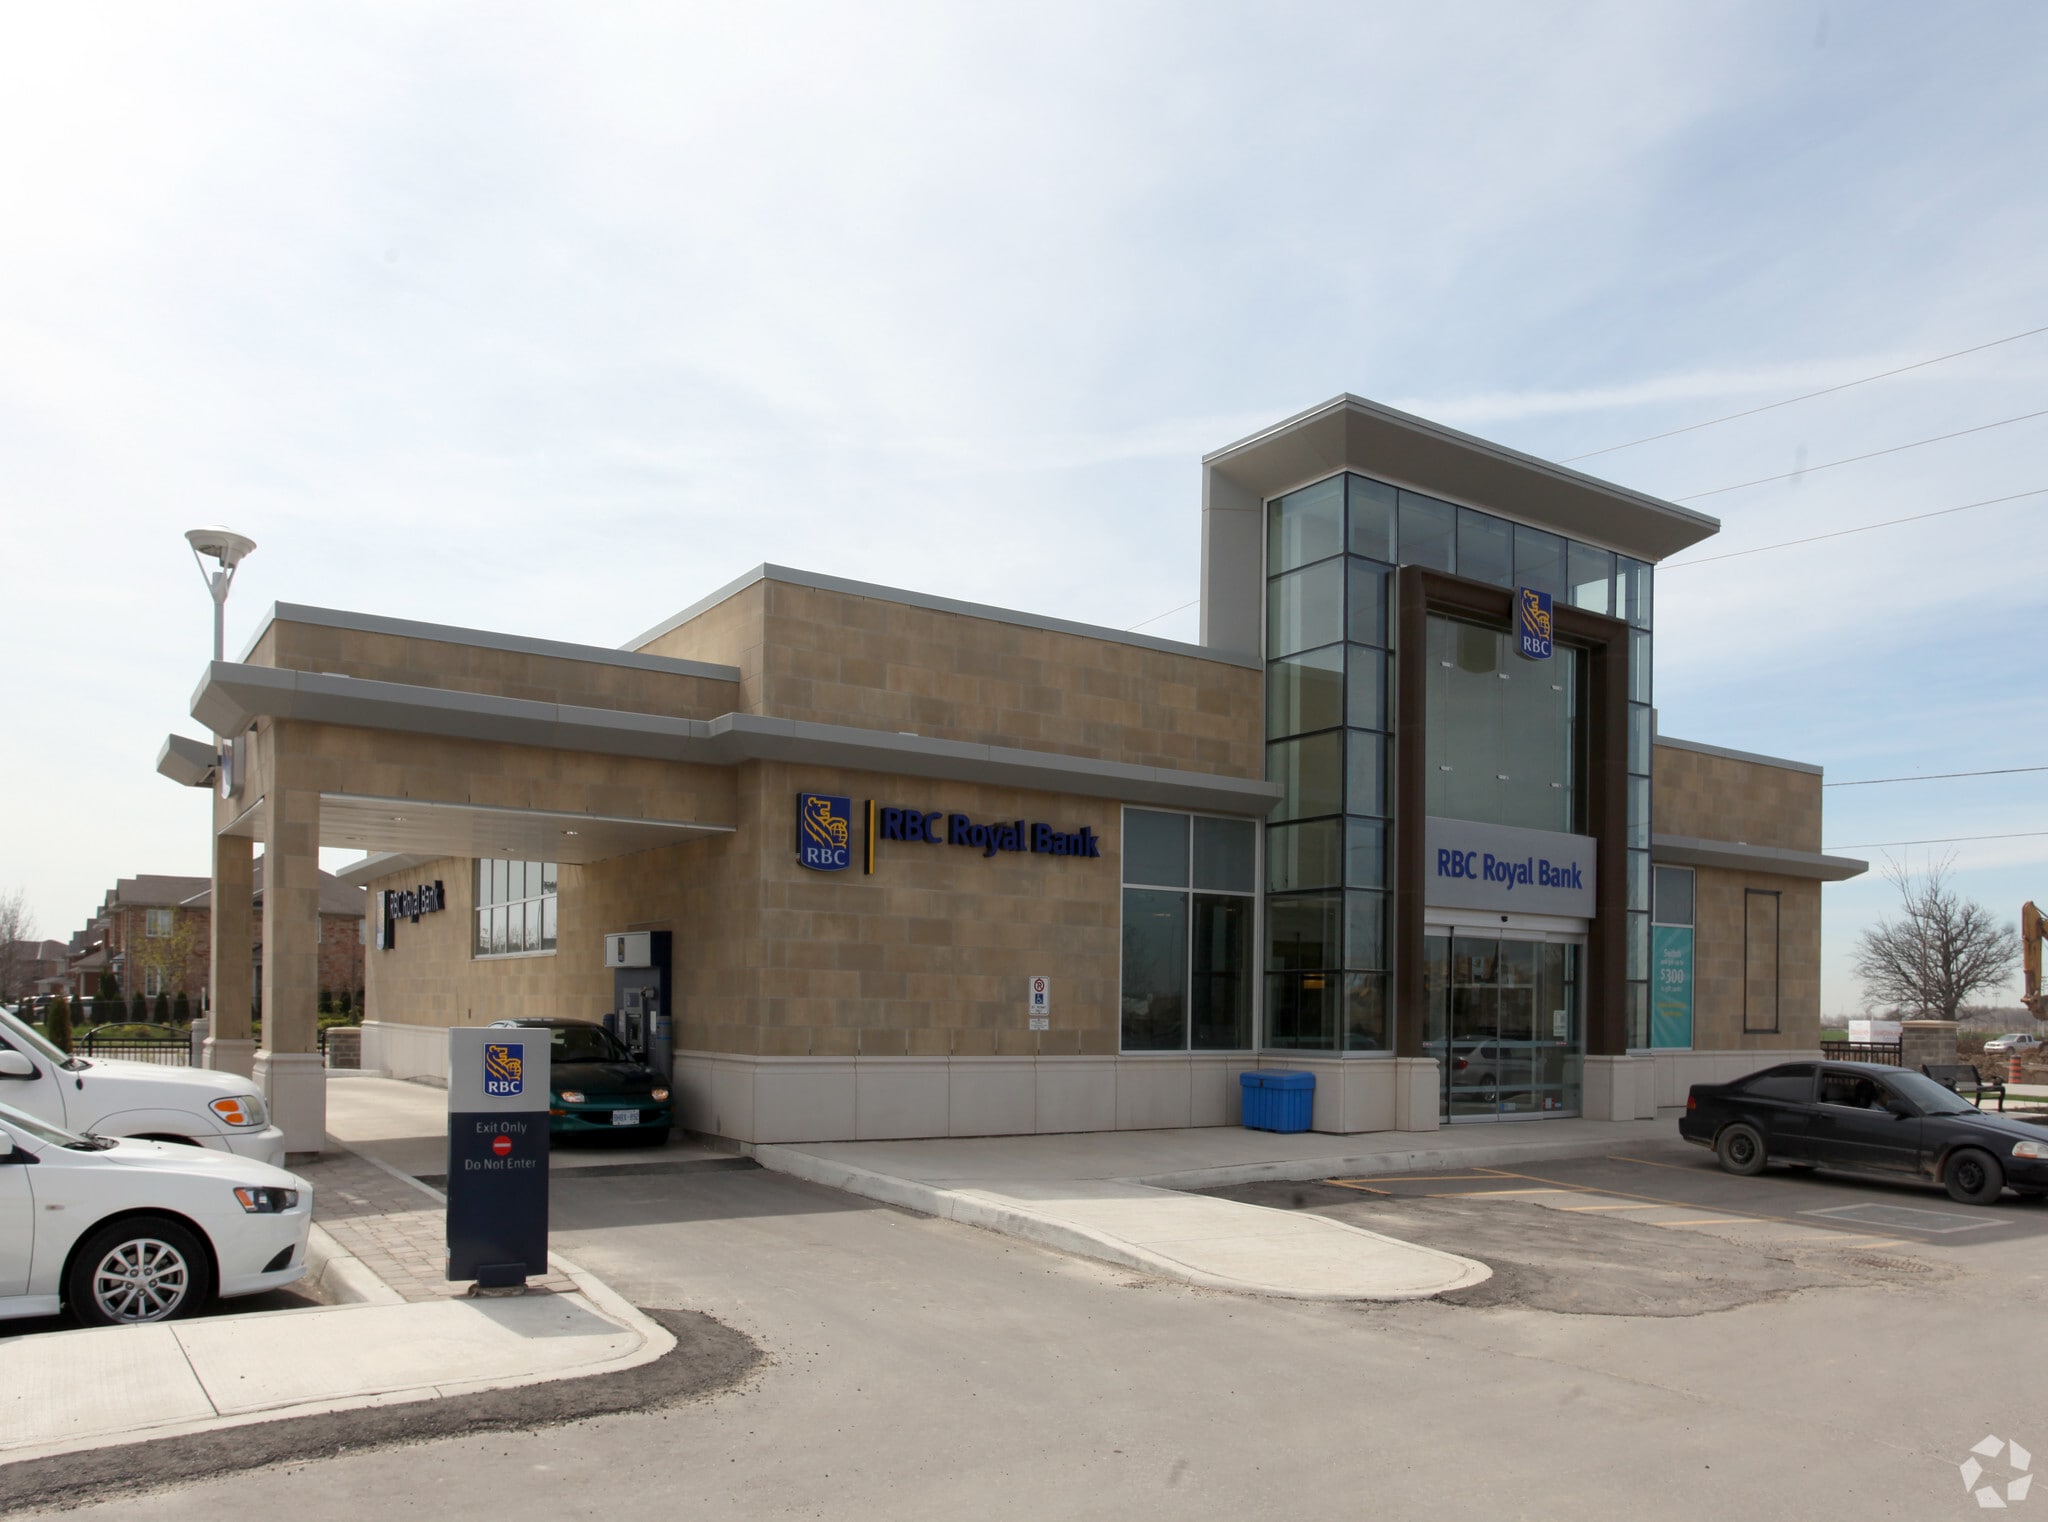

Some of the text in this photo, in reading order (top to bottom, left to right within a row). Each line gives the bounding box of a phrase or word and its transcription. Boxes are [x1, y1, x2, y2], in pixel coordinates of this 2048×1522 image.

[1523, 636, 1549, 656] RBC
[880, 807, 1100, 858] RBC Royal Bank
[807, 847, 846, 866] RBC
[1438, 848, 1583, 890] RBC Royal Bank
[420, 883, 440, 913] Bank
[1660, 968, 1684, 985] $300
[488, 1081, 520, 1093] RBC
[476, 1121, 527, 1135] Exit Only
[465, 1158, 536, 1171] Do Not Enter
